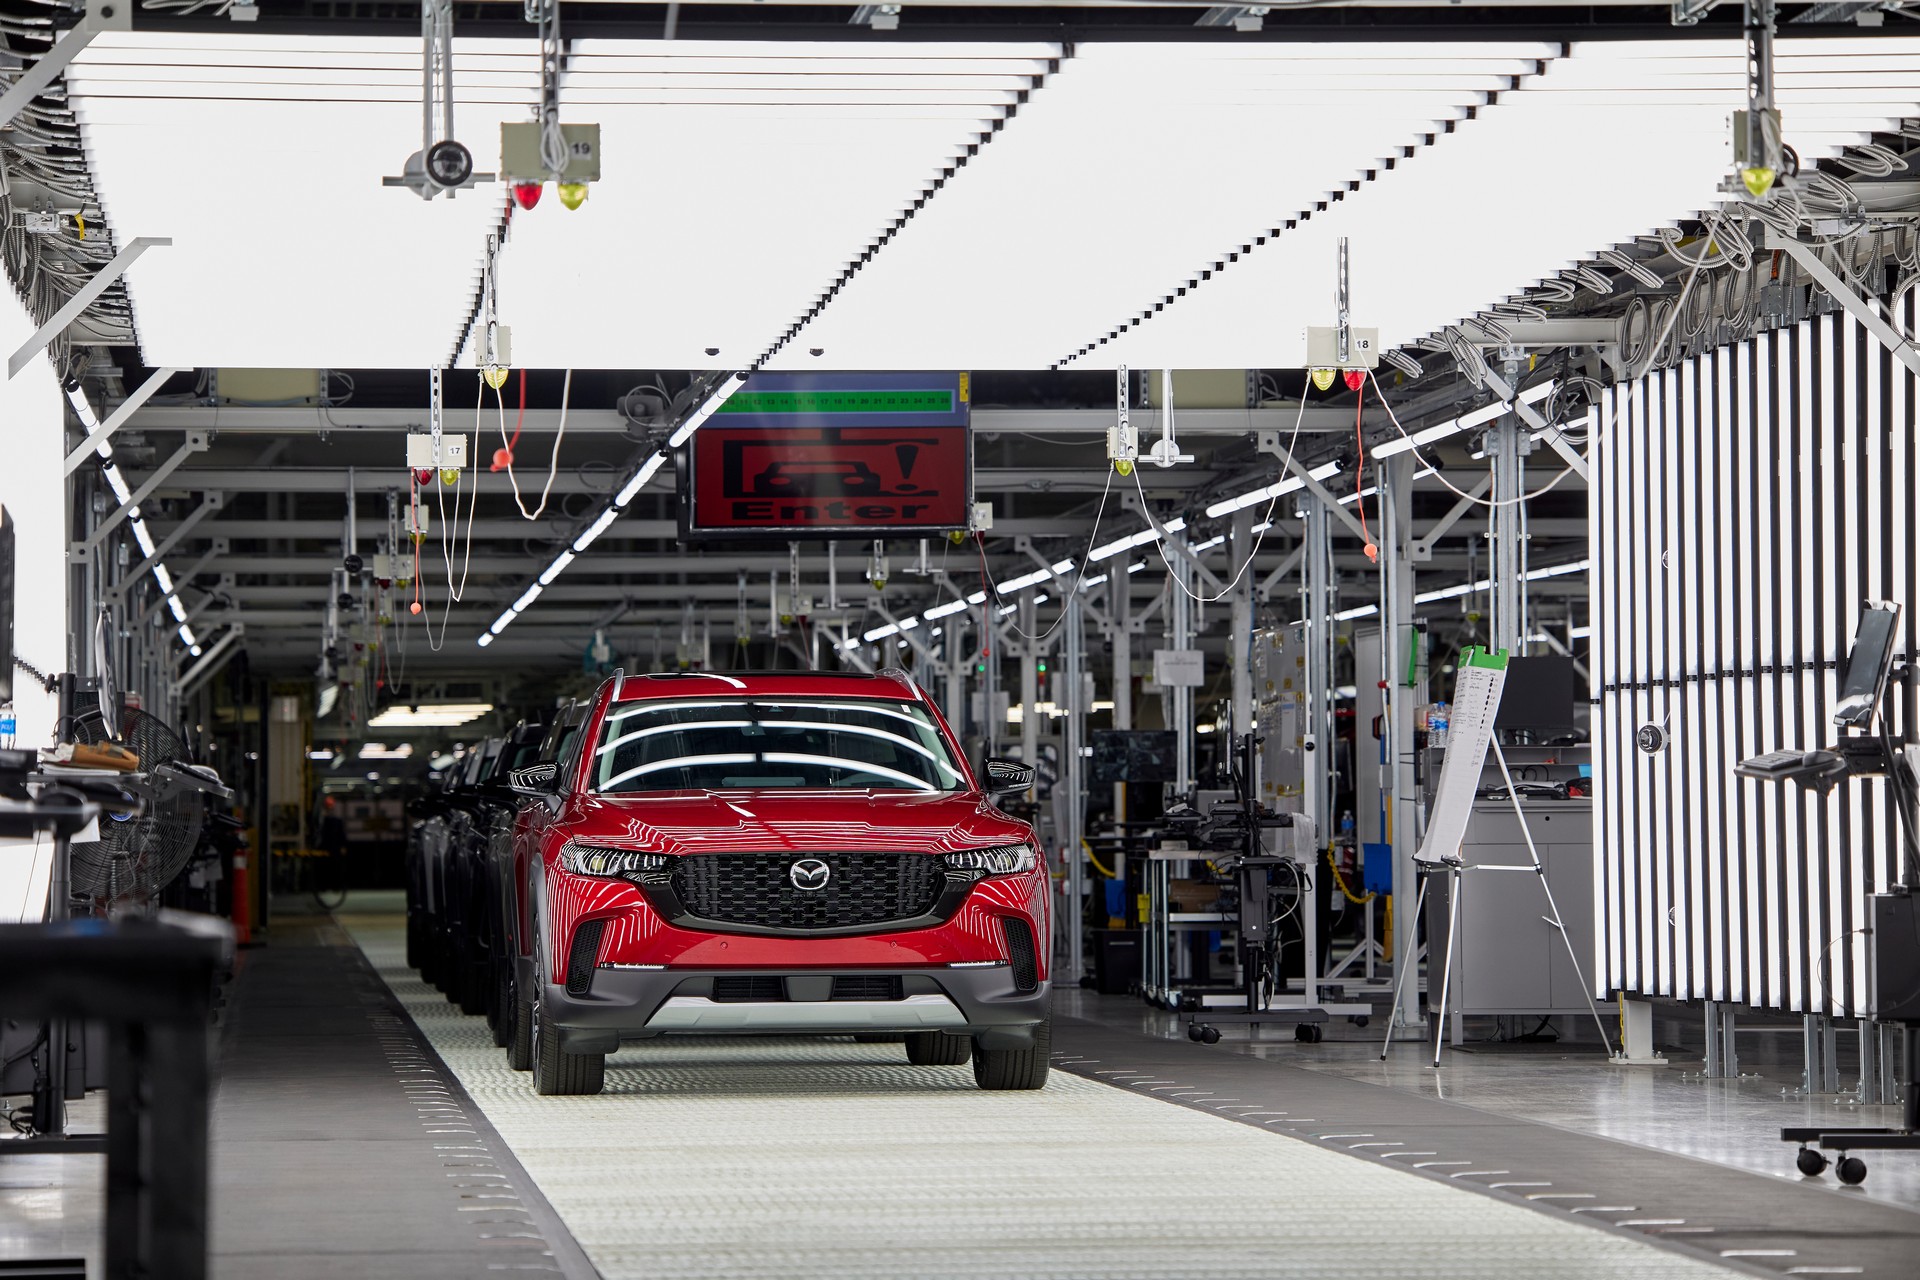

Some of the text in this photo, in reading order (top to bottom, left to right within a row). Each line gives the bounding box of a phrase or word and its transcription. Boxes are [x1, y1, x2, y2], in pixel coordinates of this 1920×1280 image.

[571, 142, 591, 155] 19
[1357, 340, 1369, 349] 18
[450, 447, 461, 455] 17
[732, 501, 929, 520] Enter
